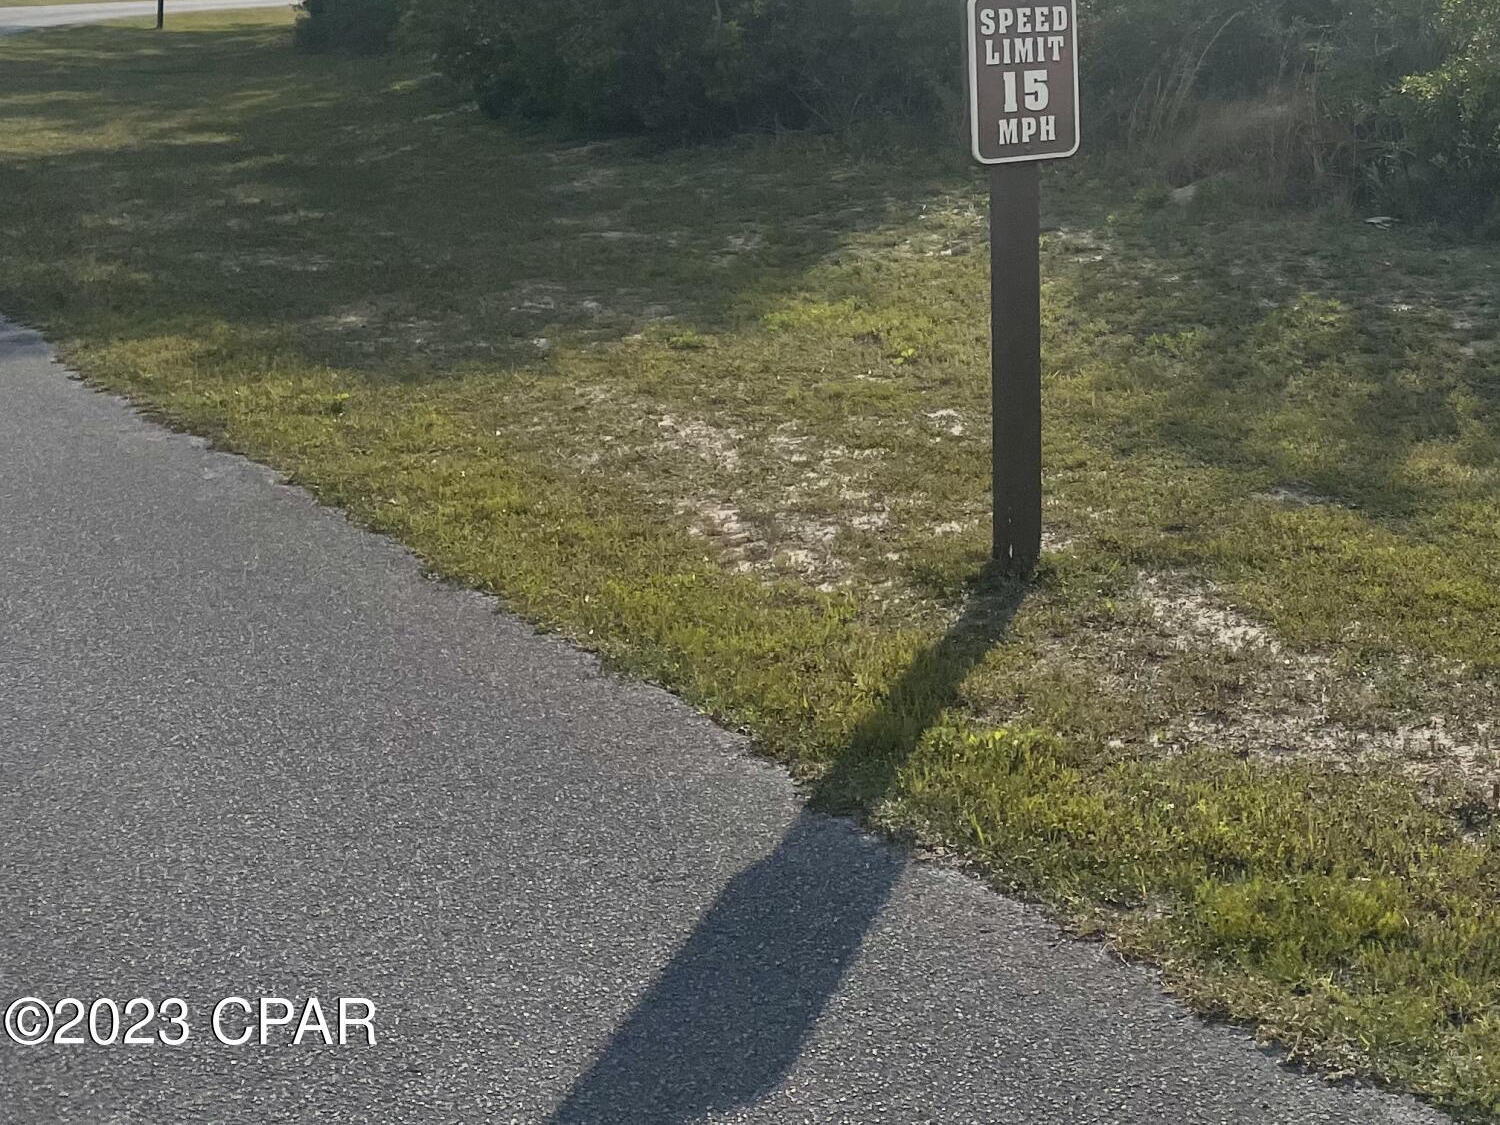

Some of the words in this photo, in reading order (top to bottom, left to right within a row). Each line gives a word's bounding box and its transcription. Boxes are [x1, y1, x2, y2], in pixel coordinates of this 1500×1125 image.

[980, 6, 1068, 35] SPEED
[985, 36, 1064, 65] LIMIT
[1003, 69, 1049, 113] 15
[998, 115, 1056, 145] MPH
